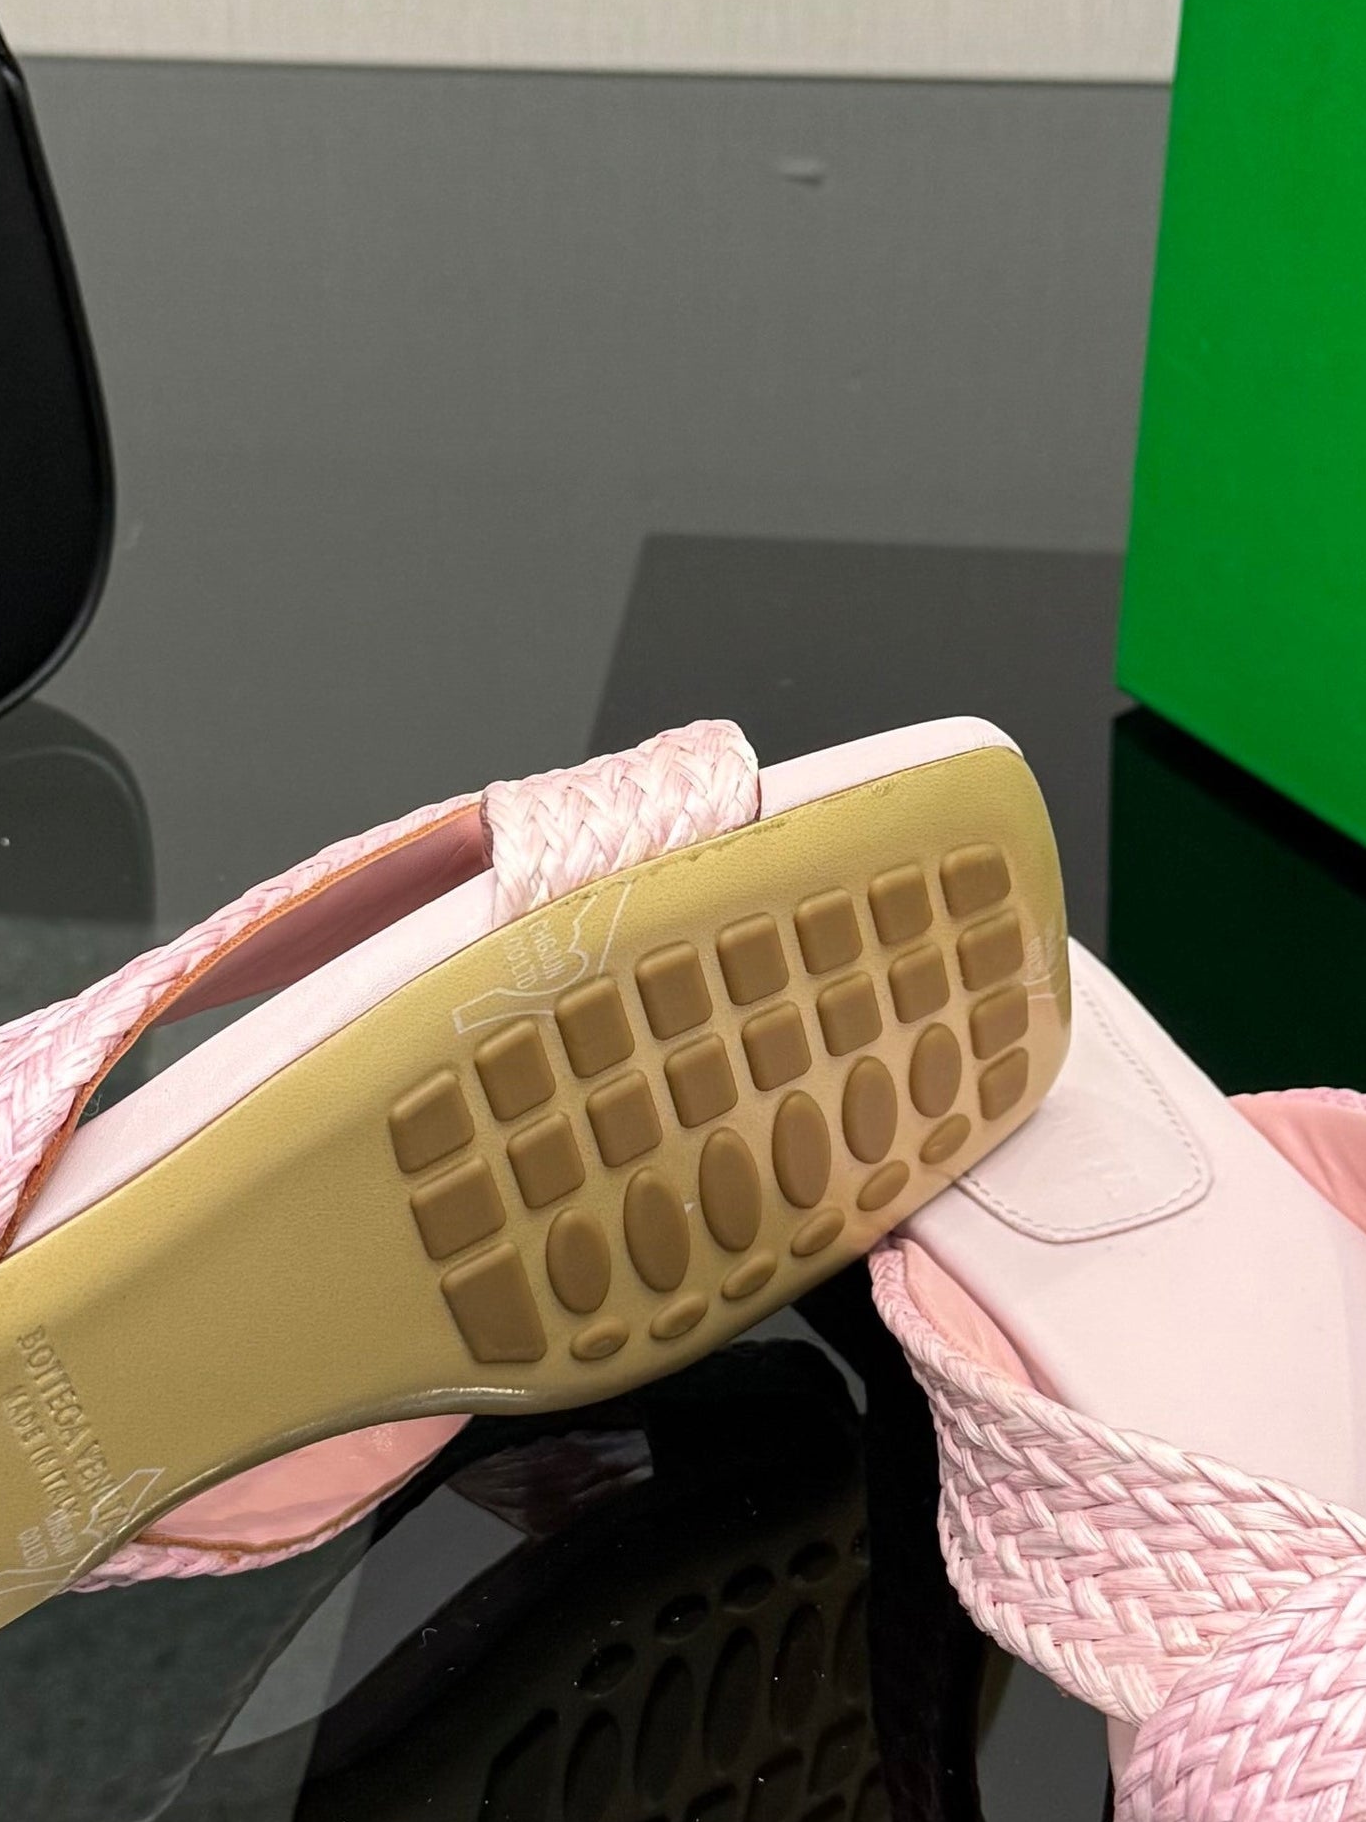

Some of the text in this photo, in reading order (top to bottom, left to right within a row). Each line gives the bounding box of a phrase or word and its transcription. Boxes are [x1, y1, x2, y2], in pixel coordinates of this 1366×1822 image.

[1, 1384, 82, 1519] MADE IN ITALY
[16, 1324, 92, 1451] BOTTEGA
